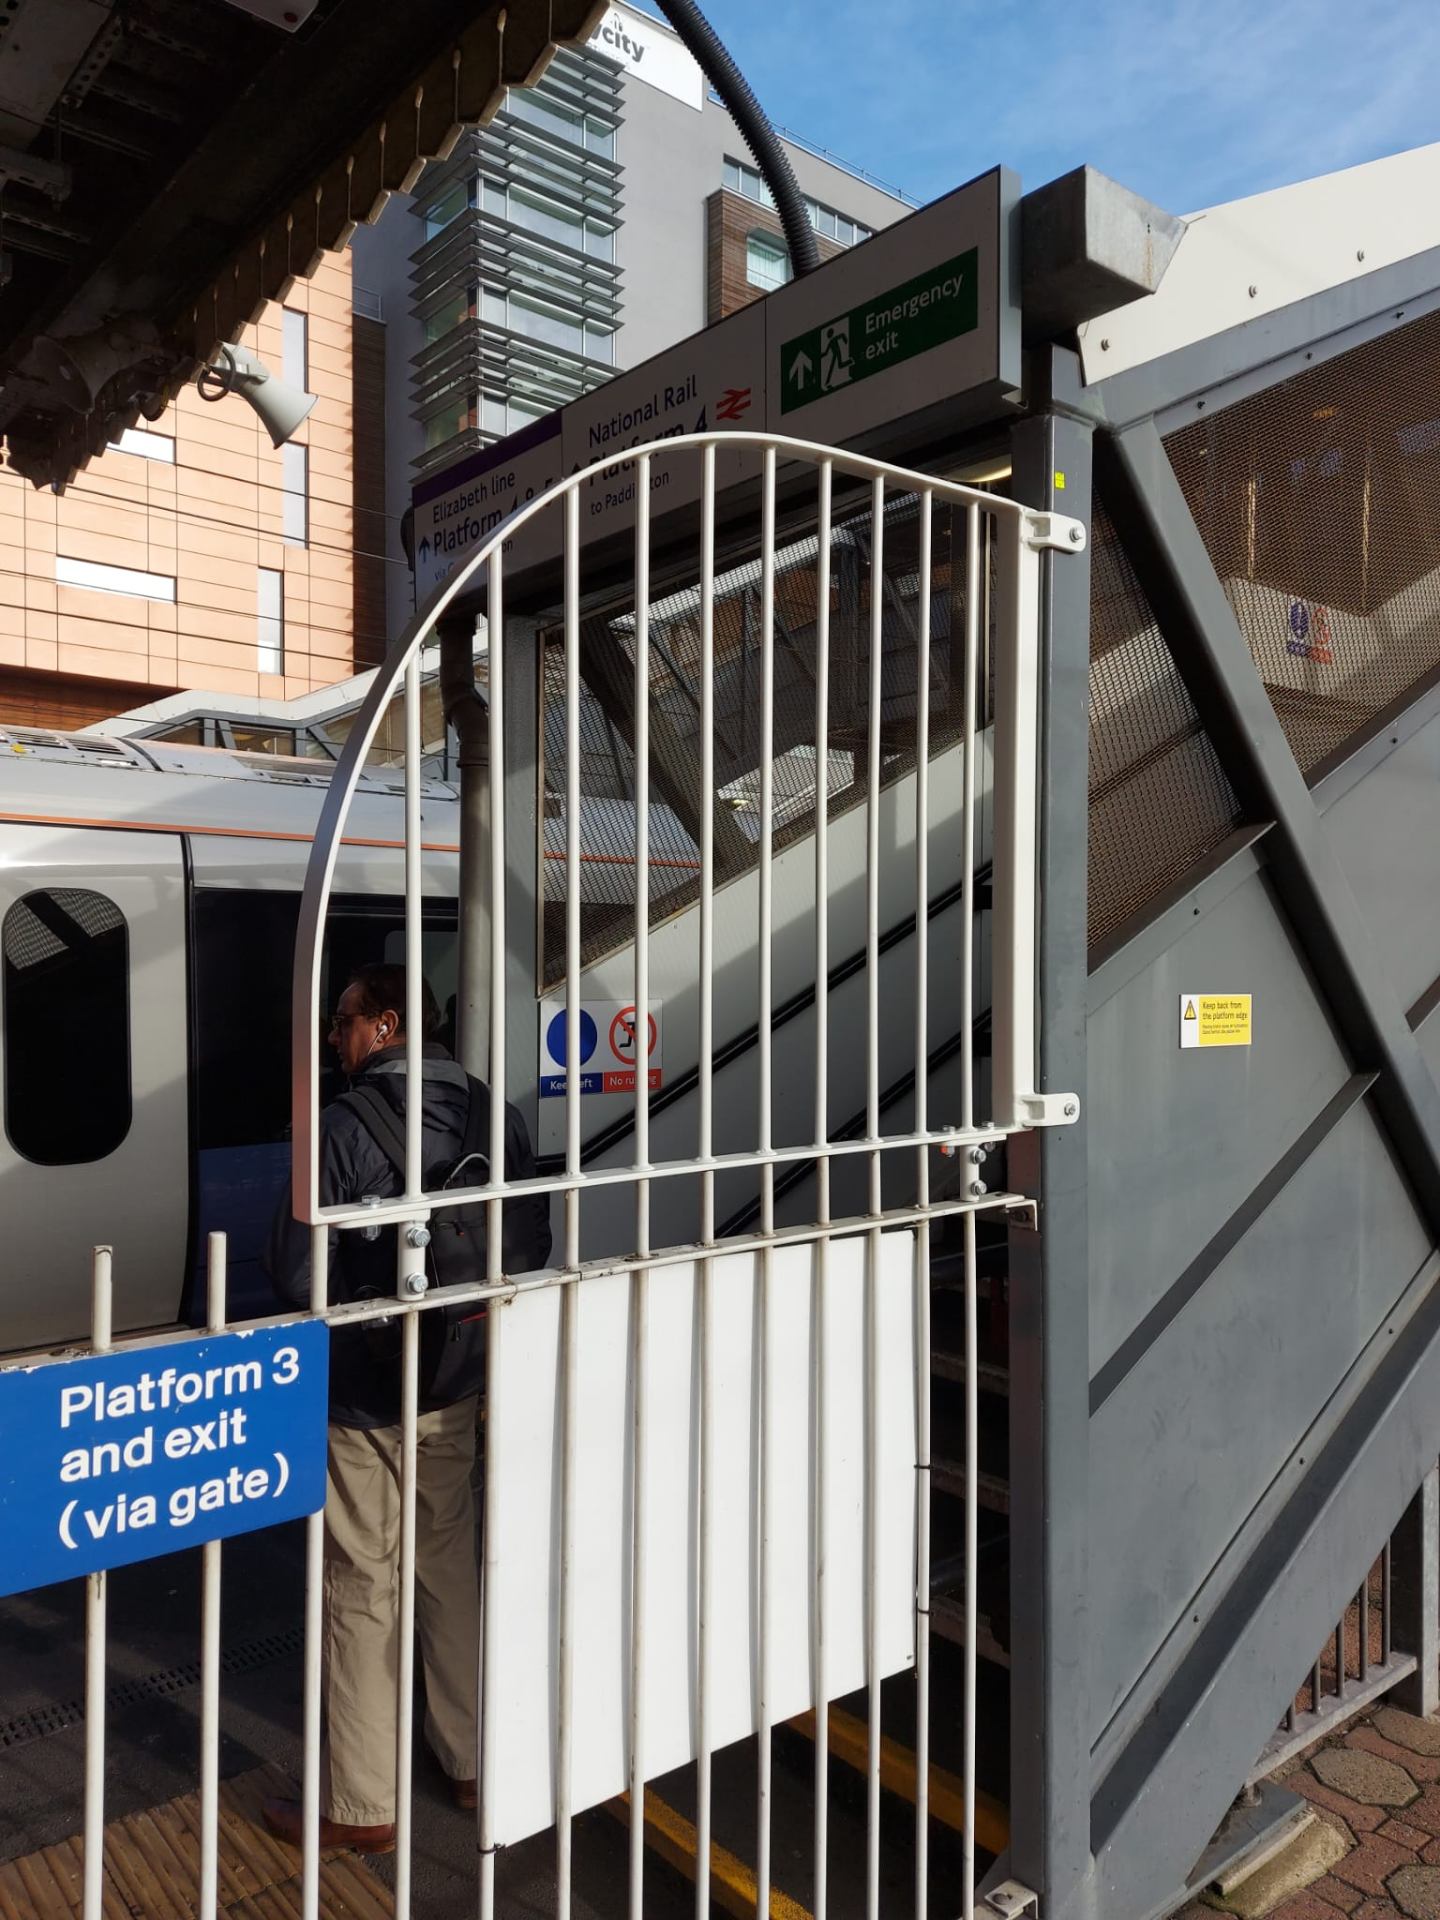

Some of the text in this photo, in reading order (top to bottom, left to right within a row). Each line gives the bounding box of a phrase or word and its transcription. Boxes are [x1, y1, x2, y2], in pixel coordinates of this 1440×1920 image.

[865, 273, 964, 335] Emergency
[865, 331, 899, 360] exit
[589, 374, 698, 449] National Rail
[432, 481, 488, 524] Elizabeth
[491, 471, 516, 496] line
[591, 471, 670, 516] to Padditon
[433, 509, 502, 557] Platform
[609, 1076, 622, 1086] No
[60, 1347, 300, 1428] Platform 3
[60, 1408, 247, 1482] and exit
[59, 1452, 289, 1549] (via gate)
